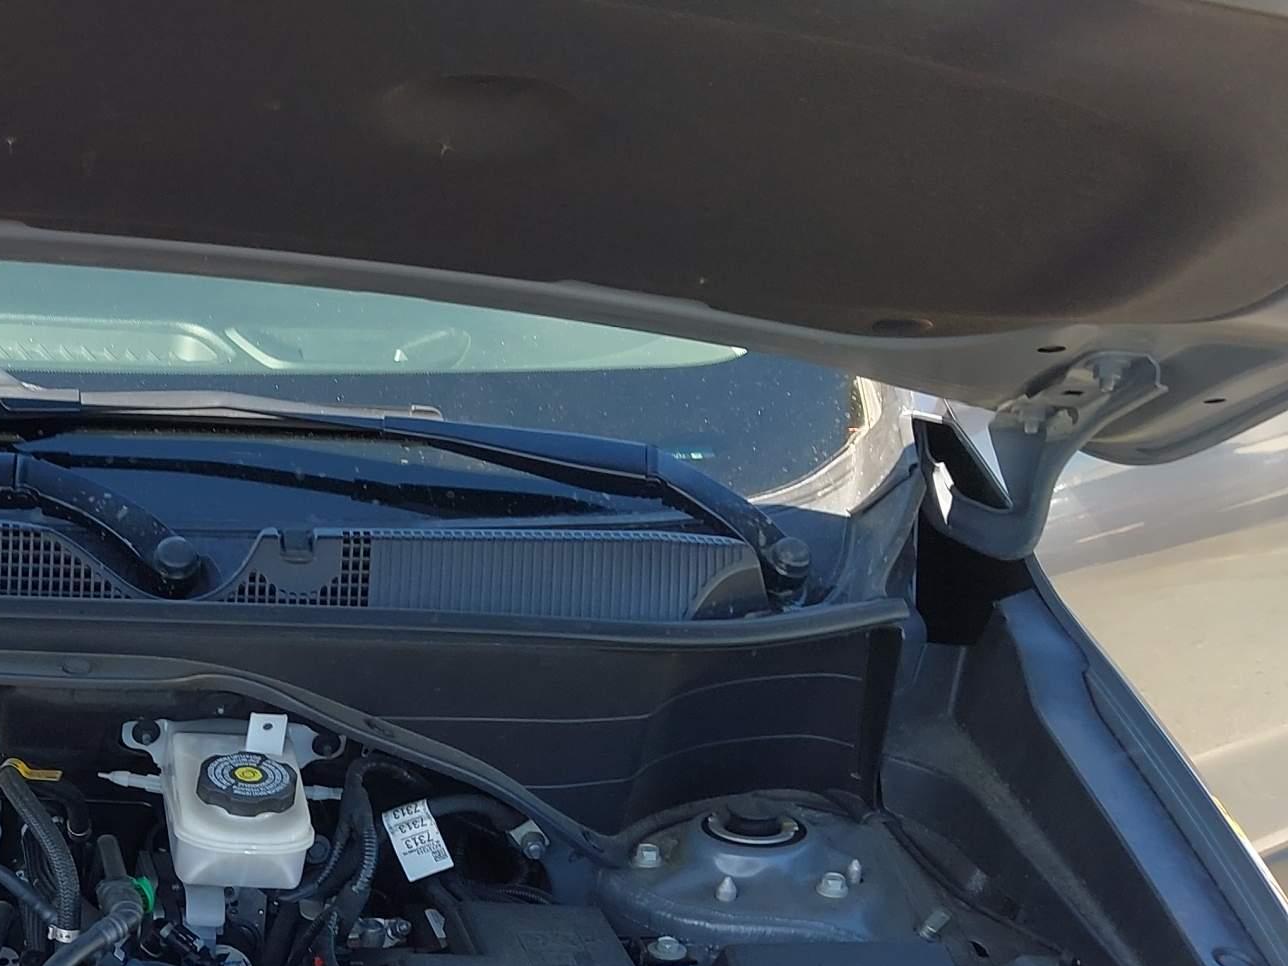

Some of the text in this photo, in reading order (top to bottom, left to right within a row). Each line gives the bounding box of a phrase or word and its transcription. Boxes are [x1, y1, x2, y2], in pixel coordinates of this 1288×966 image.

[392, 802, 421, 820] 7313
[398, 817, 428, 834] 7313
[404, 831, 434, 850] 7313
